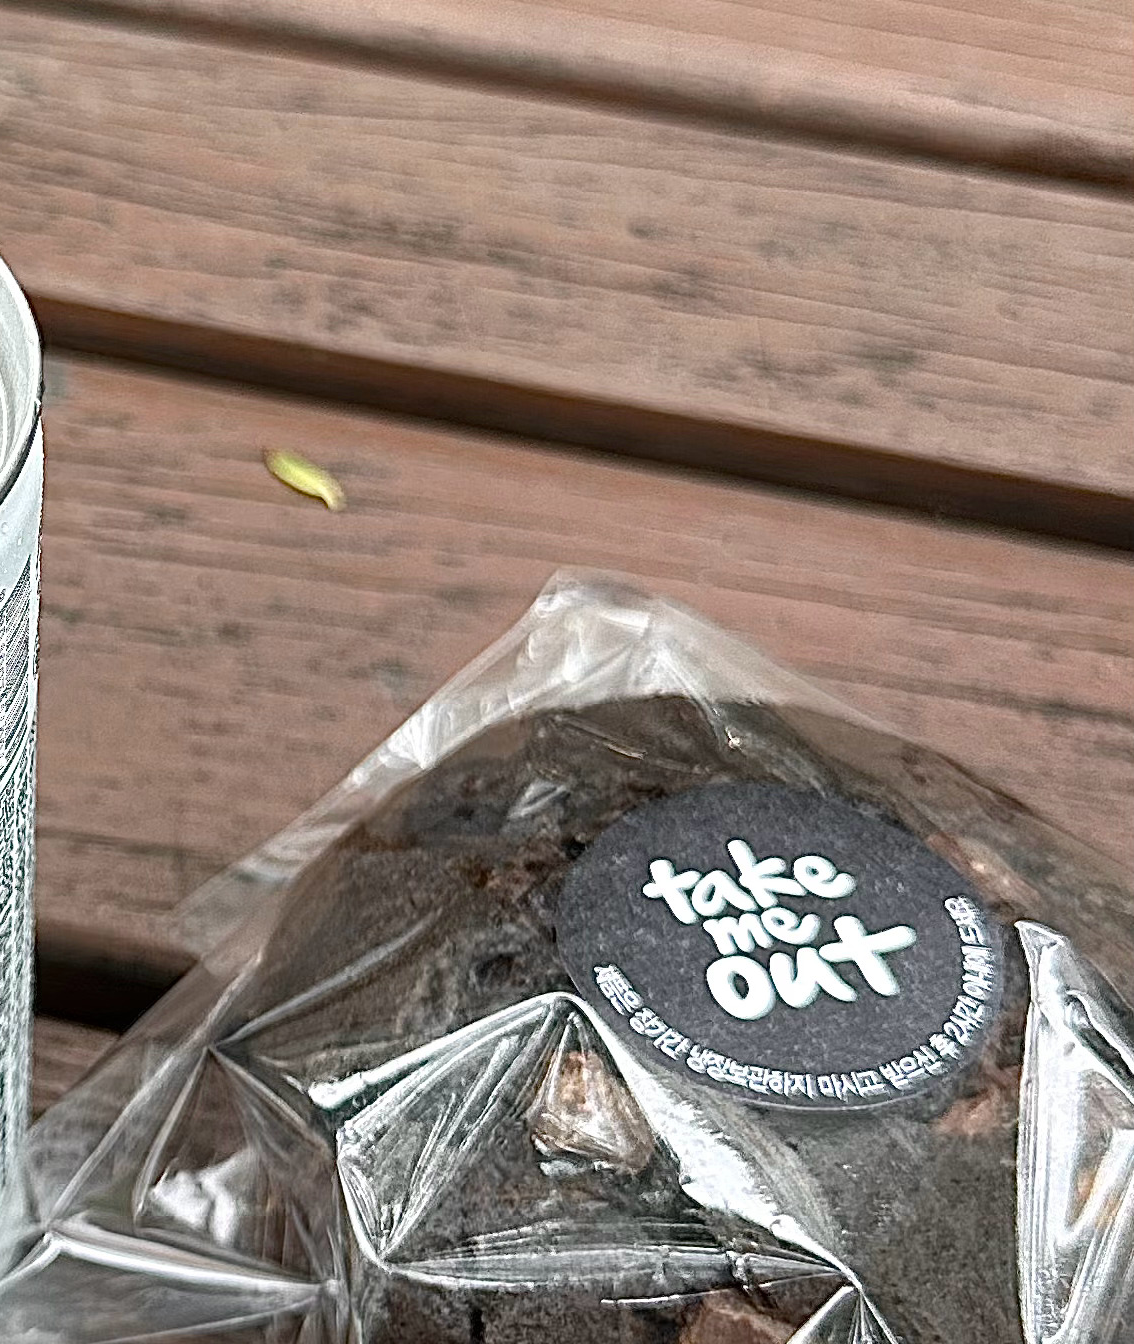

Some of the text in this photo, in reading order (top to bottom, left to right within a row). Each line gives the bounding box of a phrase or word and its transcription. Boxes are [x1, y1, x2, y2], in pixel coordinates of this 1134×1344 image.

[642, 838, 859, 925] take
[702, 906, 822, 956] me
[705, 914, 918, 1021] out
[629, 1006, 691, 1061] 장기간
[686, 1046, 816, 1099] 냉장보관하지
[818, 1069, 886, 1099] 마시고
[879, 1046, 942, 1090] 받으신
[929, 1032, 962, 1060] 후
